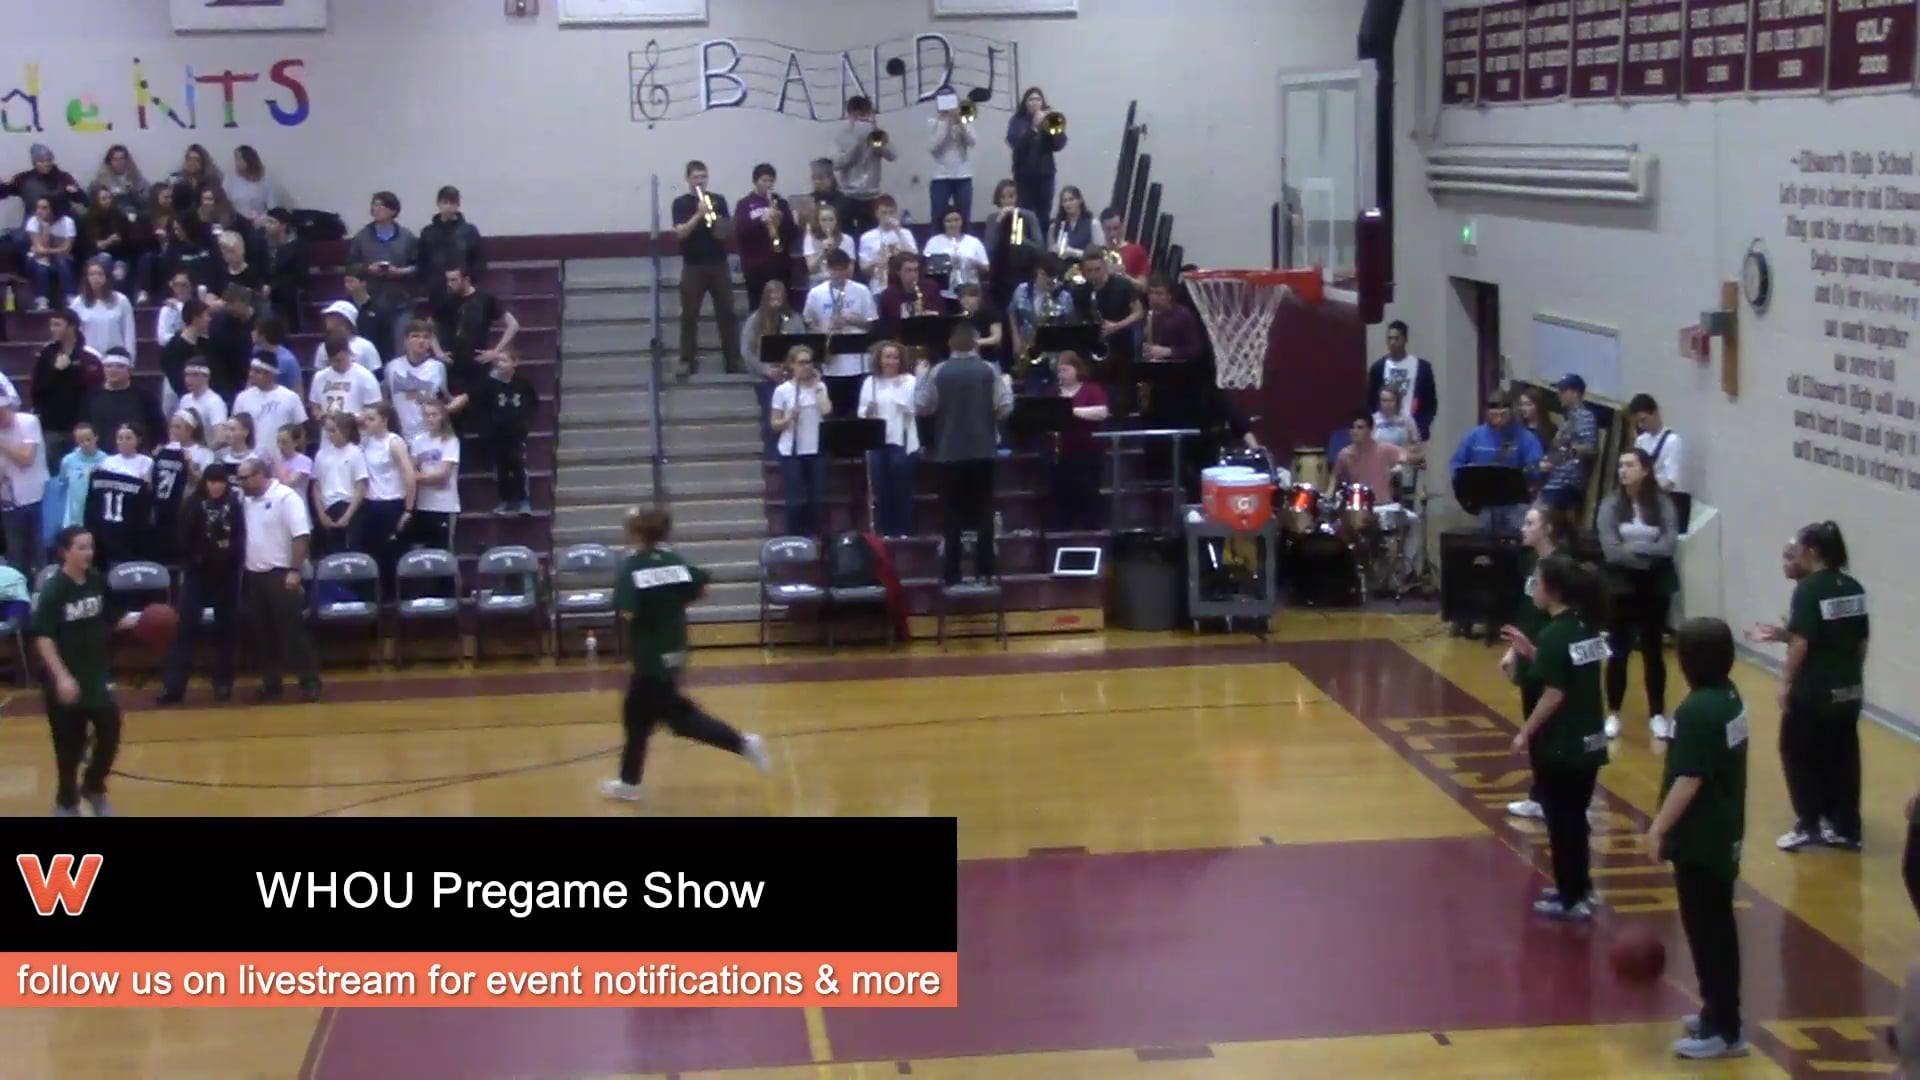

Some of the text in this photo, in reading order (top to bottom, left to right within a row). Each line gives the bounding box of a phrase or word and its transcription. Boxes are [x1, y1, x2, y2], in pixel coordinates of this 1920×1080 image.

[1855, 17, 1893, 43] GOLF
[1857, 55, 1888, 75] 2000
[1878, 150, 1913, 175] School
[103, 492, 125, 522] 11
